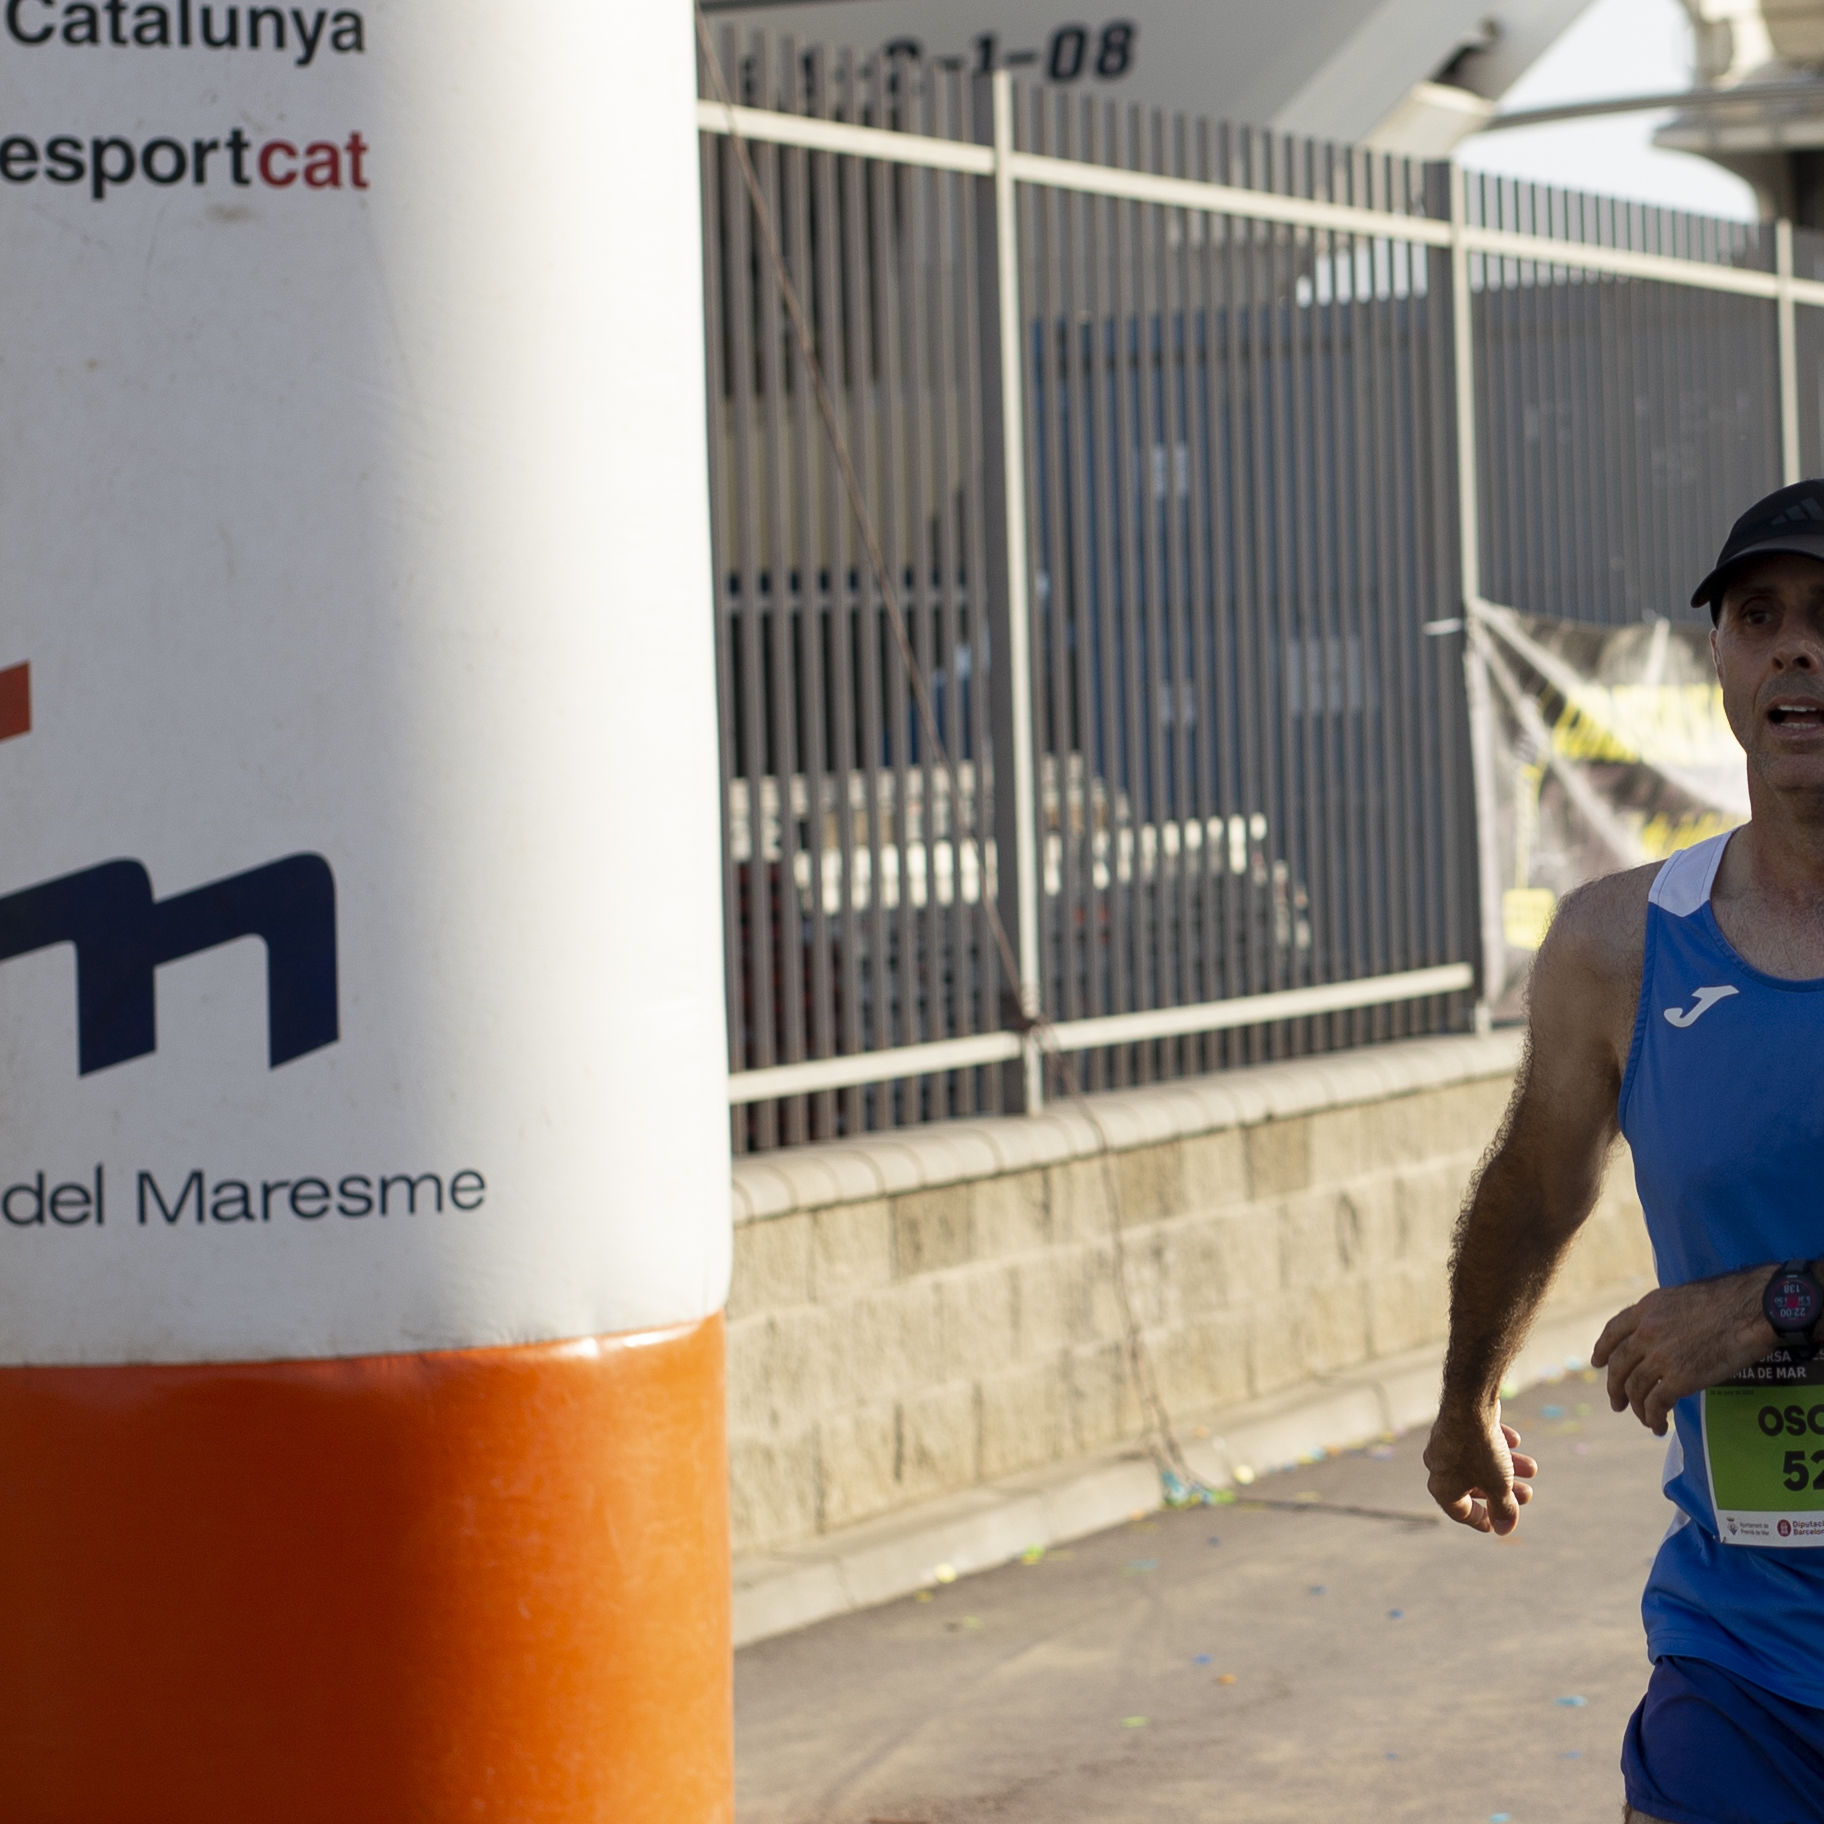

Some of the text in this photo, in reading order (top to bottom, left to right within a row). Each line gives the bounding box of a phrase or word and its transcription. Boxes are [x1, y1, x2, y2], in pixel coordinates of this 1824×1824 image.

[0, 128, 370, 200] esportcat
[3, 1164, 487, 1226] del Maresme
[1757, 1366, 1773, 1379] DE
[1776, 1366, 1807, 1379] MAR
